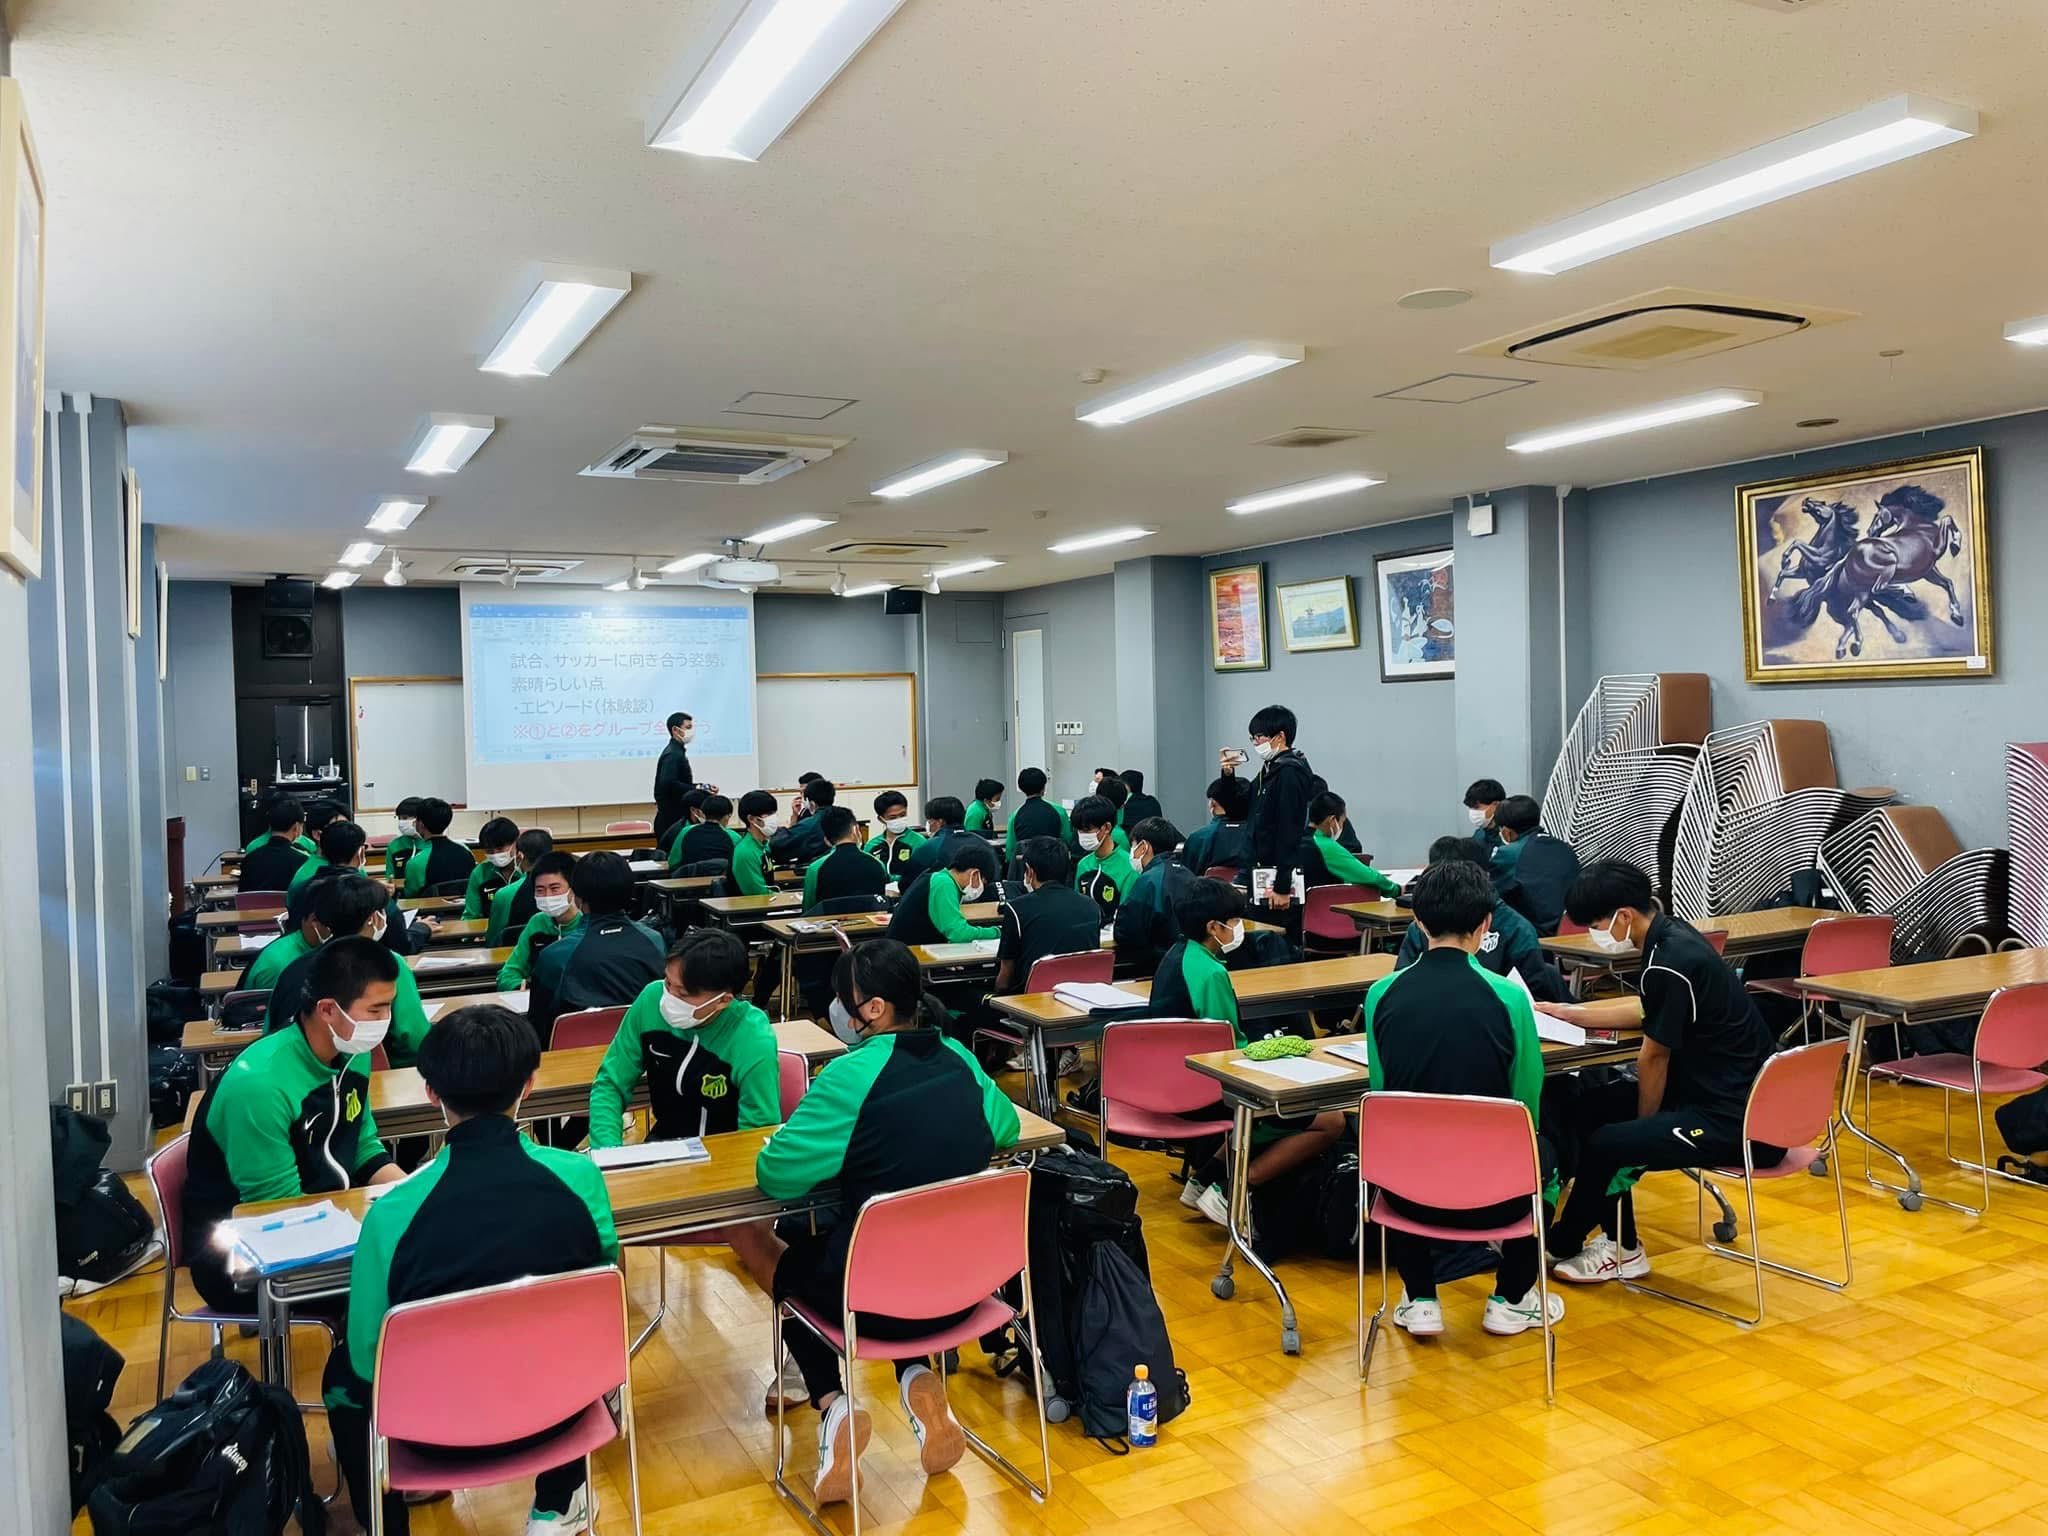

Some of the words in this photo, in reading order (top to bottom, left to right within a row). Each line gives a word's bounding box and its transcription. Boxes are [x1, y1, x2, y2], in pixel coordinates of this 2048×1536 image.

[511, 677, 605, 693] 素晴らしい点
